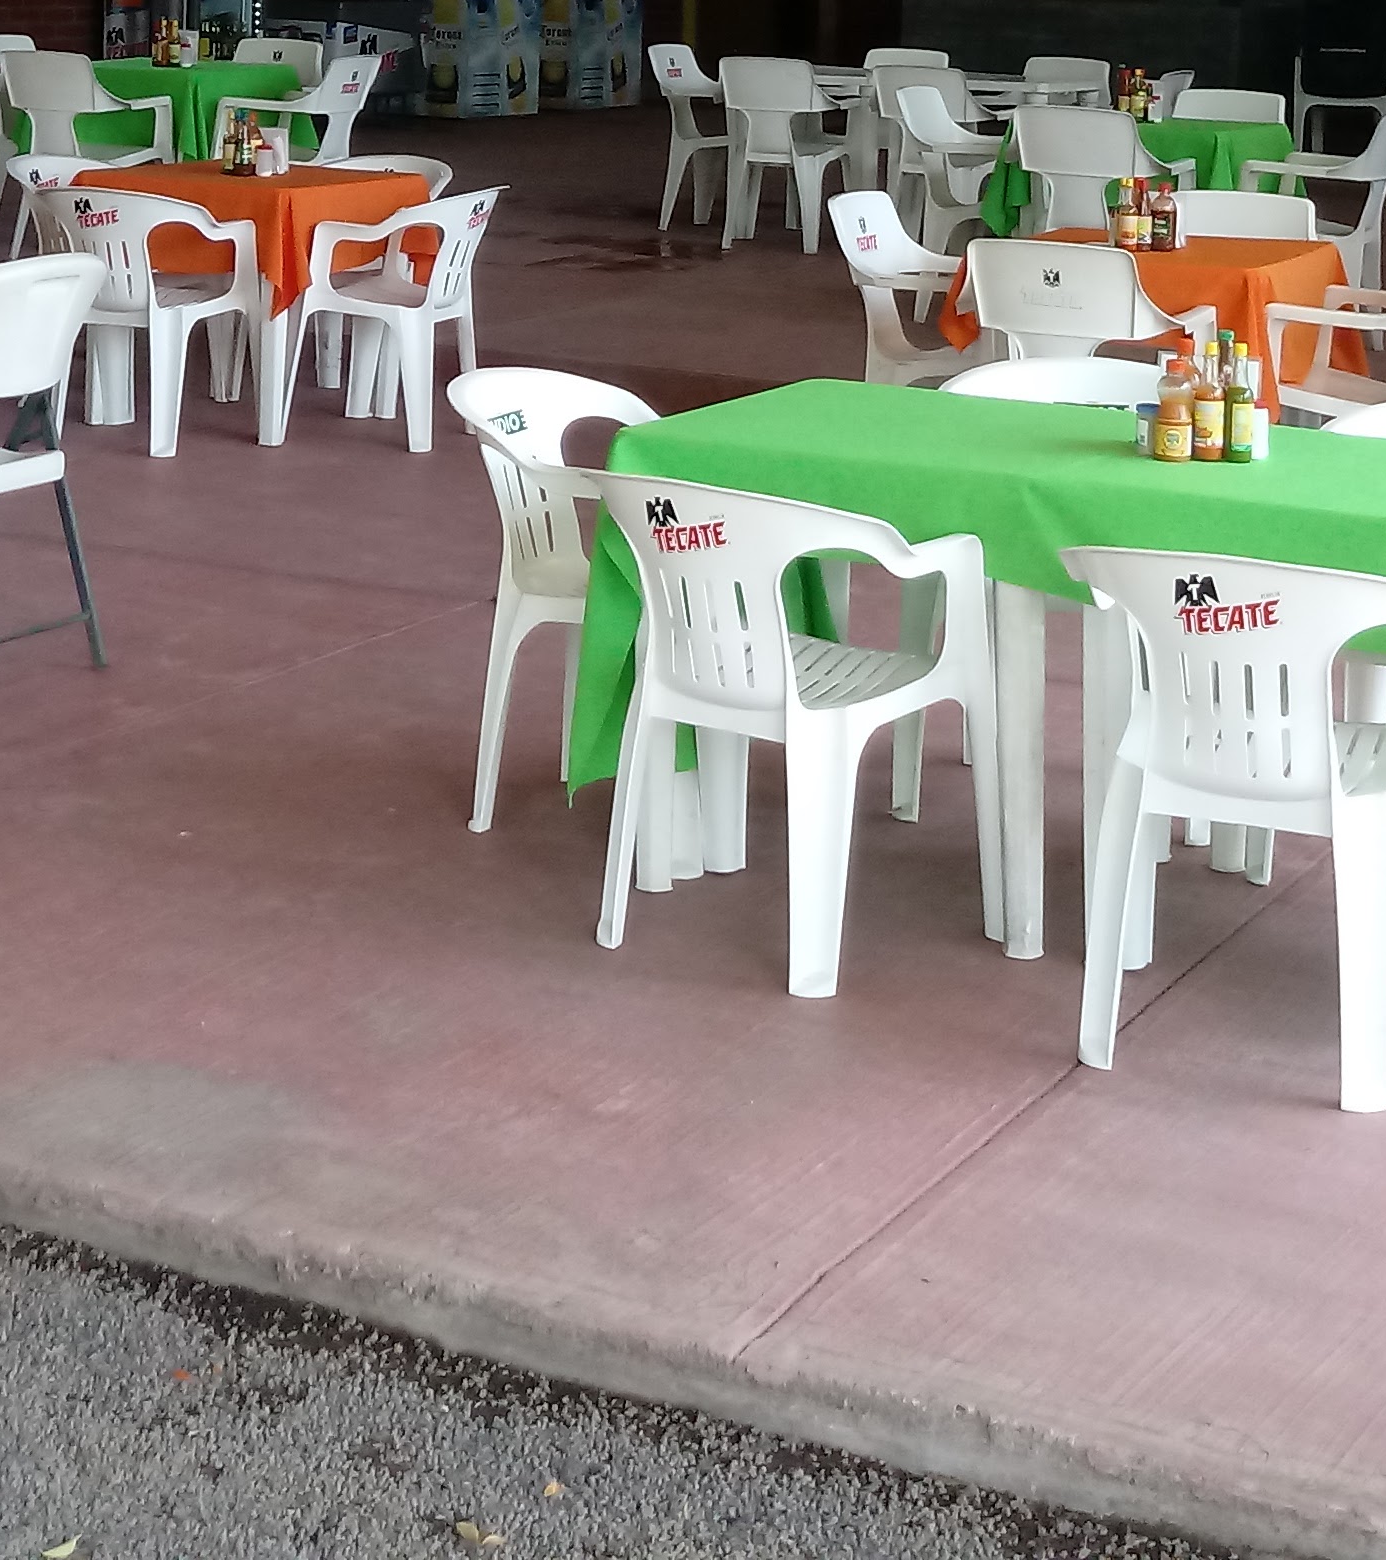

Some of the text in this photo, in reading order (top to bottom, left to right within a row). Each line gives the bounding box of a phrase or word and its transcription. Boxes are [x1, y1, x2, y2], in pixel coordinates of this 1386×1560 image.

[76, 209, 120, 229] TECATE
[651, 520, 728, 552] TECATE
[1176, 598, 1281, 634] TECATE
